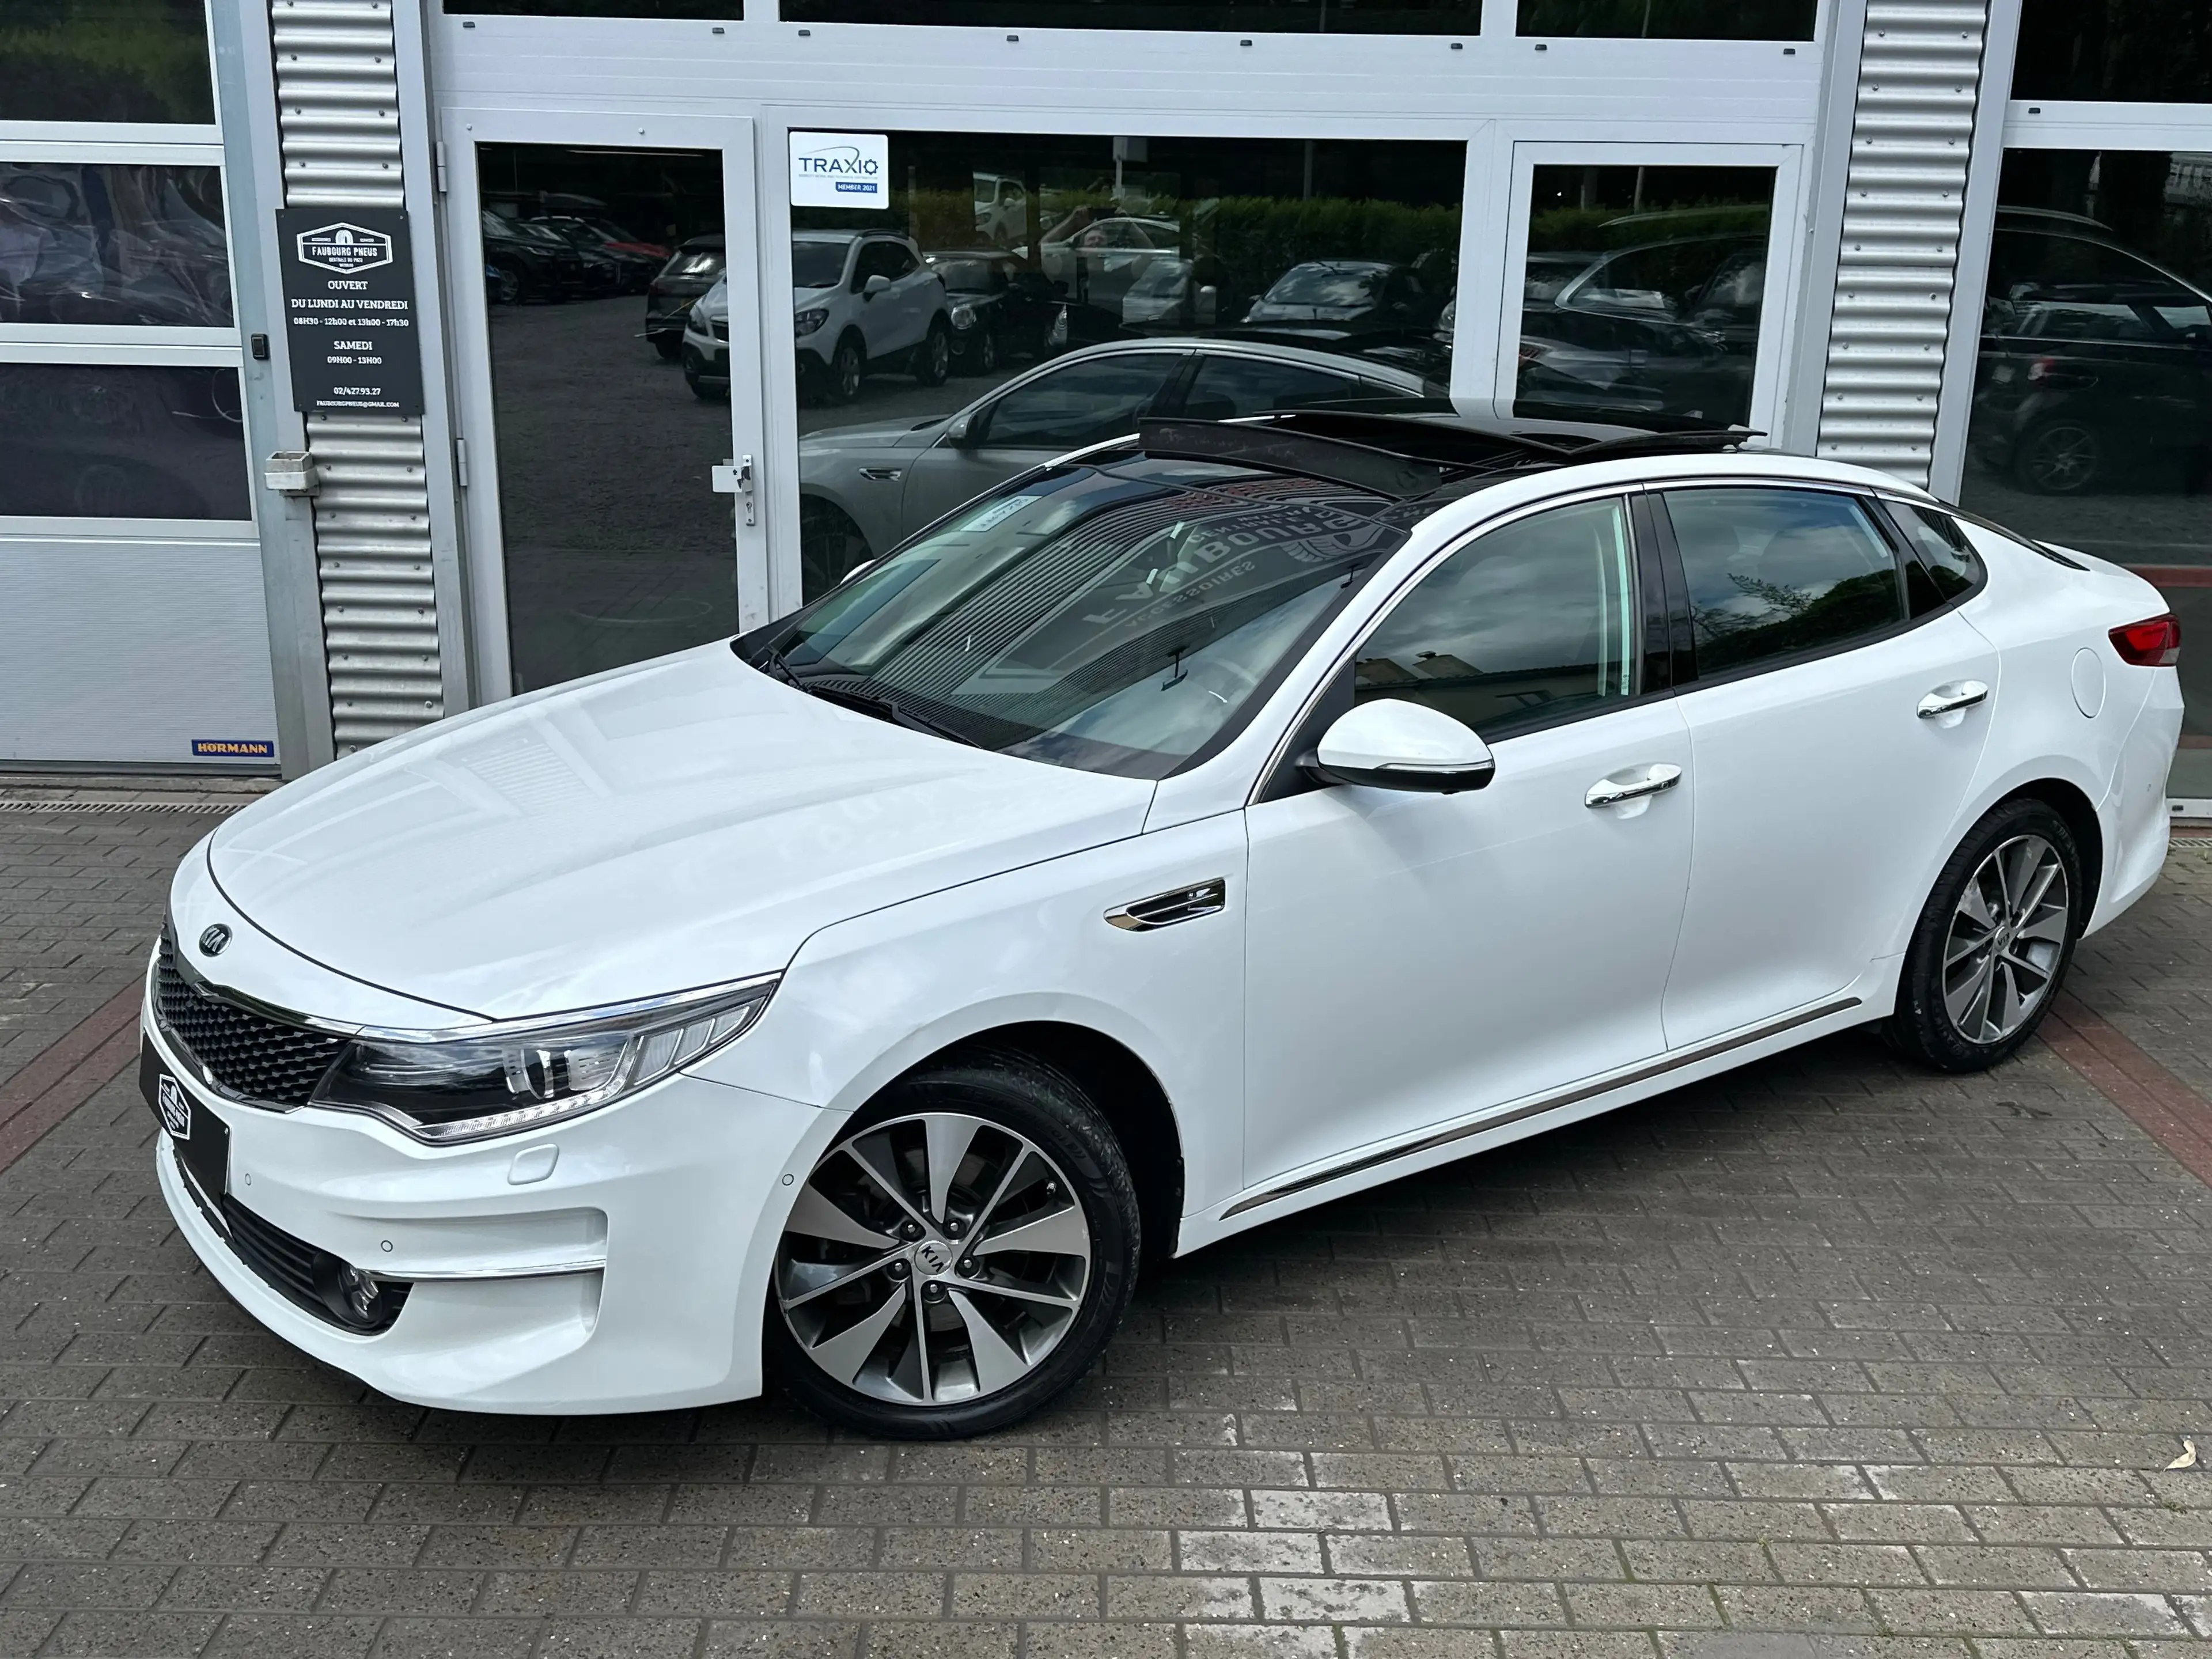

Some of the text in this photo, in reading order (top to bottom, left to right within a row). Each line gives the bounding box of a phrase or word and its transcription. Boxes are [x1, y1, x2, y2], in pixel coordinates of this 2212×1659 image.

[798, 157, 878, 175] TRAXIO
[312, 246, 378, 256] FAUBOURG PNEUS
[328, 281, 368, 290] OUVERT
[291, 299, 408, 310] DU LUNDI AU VENDREDI
[293, 317, 319, 325] 08H30
[334, 341, 373, 350] SAMEDI
[200, 926, 225, 952] KIA
[921, 1245, 944, 1272] KIA
